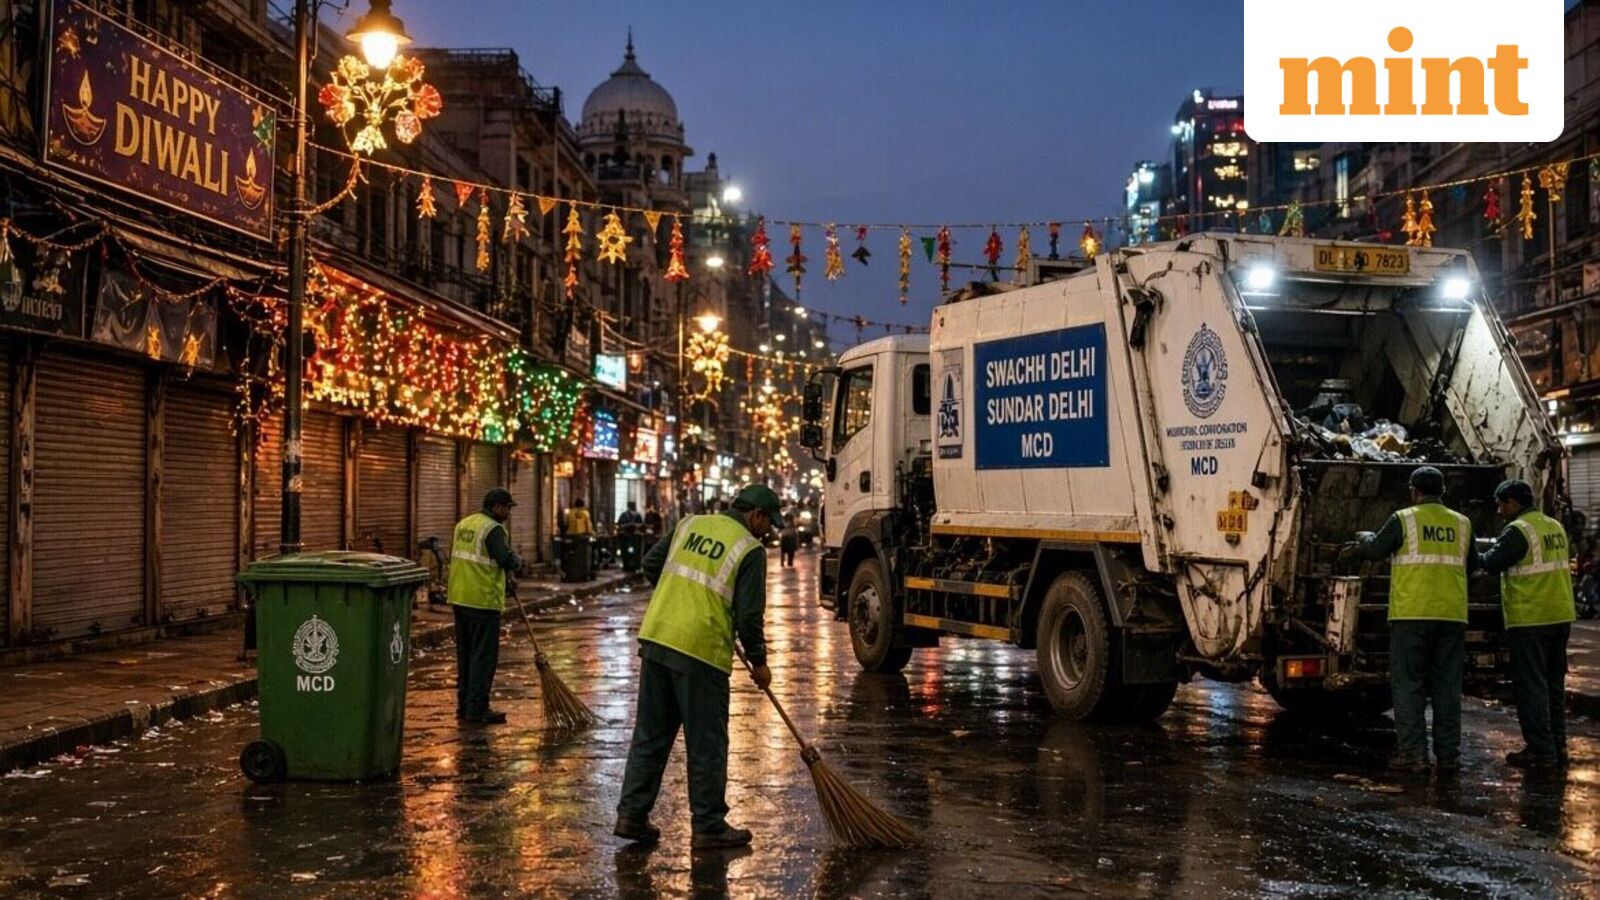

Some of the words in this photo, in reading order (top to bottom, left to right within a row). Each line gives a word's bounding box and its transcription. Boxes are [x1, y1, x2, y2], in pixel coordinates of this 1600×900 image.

[129, 54, 221, 136] HAPPY
[114, 101, 229, 197] DIWALI
[986, 353, 1046, 388] SWACHH
[1051, 346, 1095, 381] DELHI
[987, 394, 1044, 425] SUNDAR
[1049, 389, 1093, 420] DELHI
[1021, 432, 1053, 458] MCD
[1191, 456, 1218, 476] MCD
[683, 532, 725, 560] MCD
[1423, 525, 1455, 543] MCD
[1543, 533, 1565, 550] MCD
[296, 675, 335, 692] MCD
